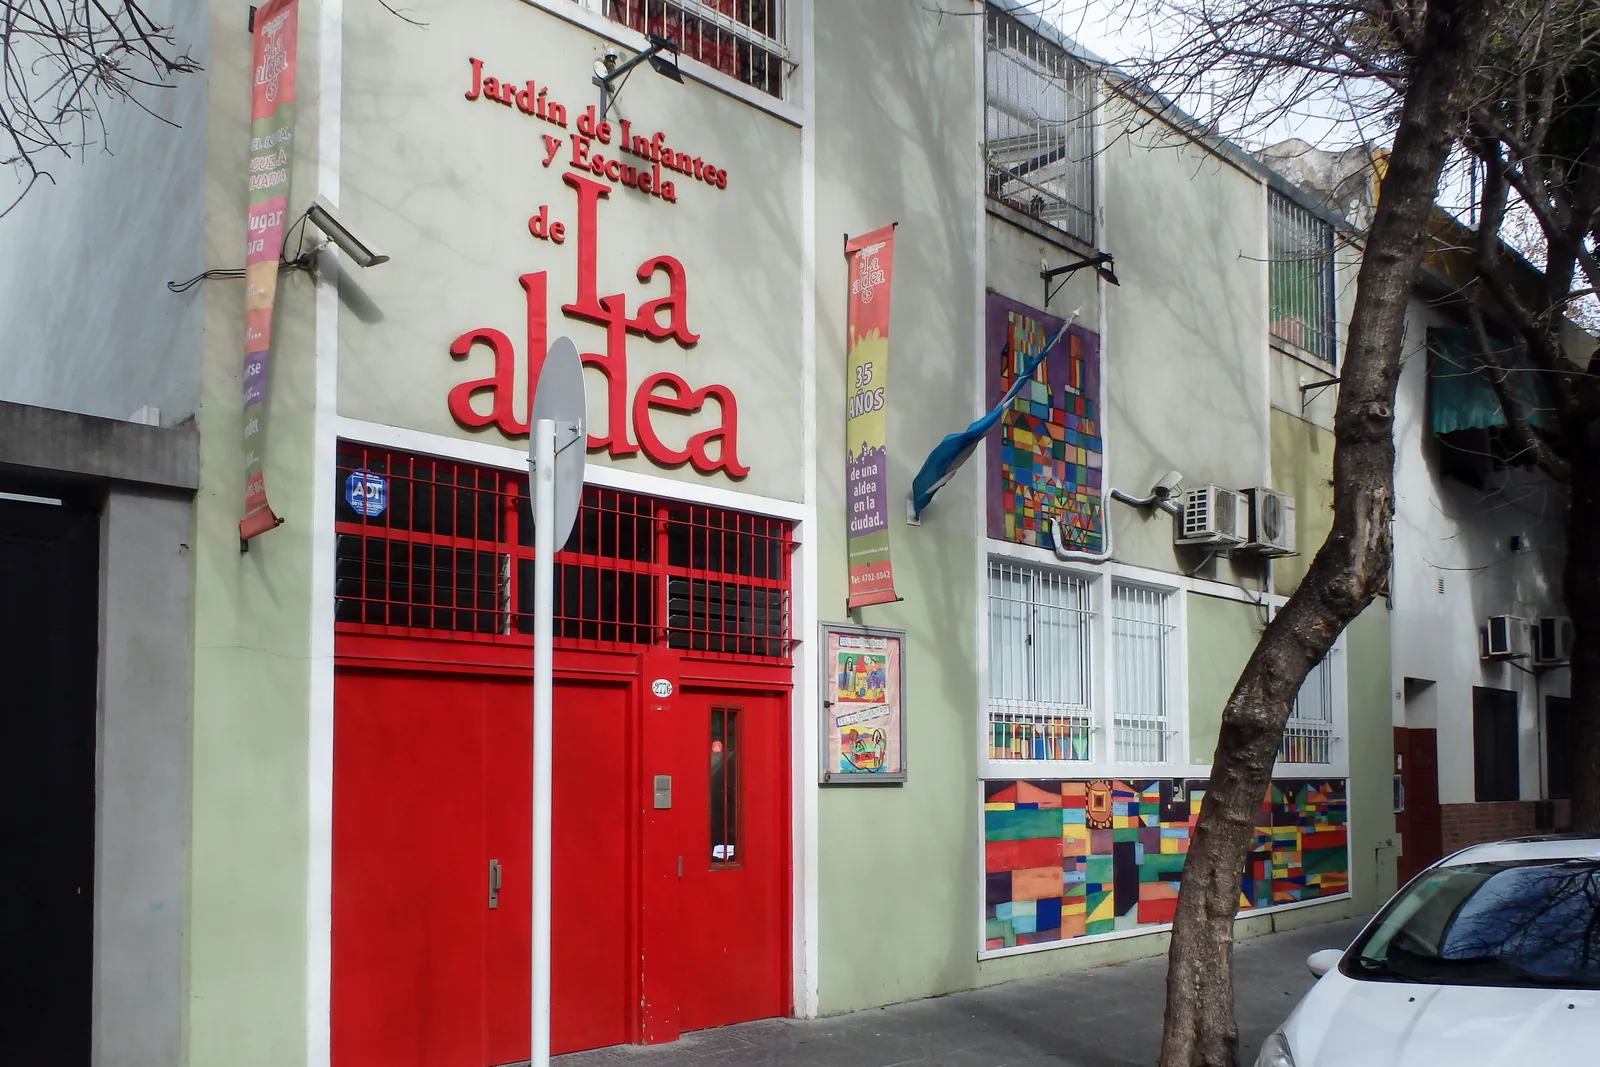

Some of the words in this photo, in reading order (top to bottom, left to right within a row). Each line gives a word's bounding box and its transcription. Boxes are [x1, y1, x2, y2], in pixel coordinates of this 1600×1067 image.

[465, 57, 567, 127] Jardín
[576, 104, 611, 144] de
[618, 118, 728, 190] Infantes
[541, 134, 562, 166] y
[569, 133, 677, 204] Escuela
[528, 205, 565, 244] de
[561, 171, 701, 348] La
[447, 270, 751, 478] aldea
[855, 361, 873, 389] 35
[848, 387, 885, 420] AÑOS
[850, 466, 860, 481] de
[861, 463, 878, 478] una
[352, 481, 383, 500] ADT
[853, 481, 877, 497] aldea
[854, 501, 865, 513] en
[866, 496, 876, 510] la
[850, 512, 884, 532] ciudad.
